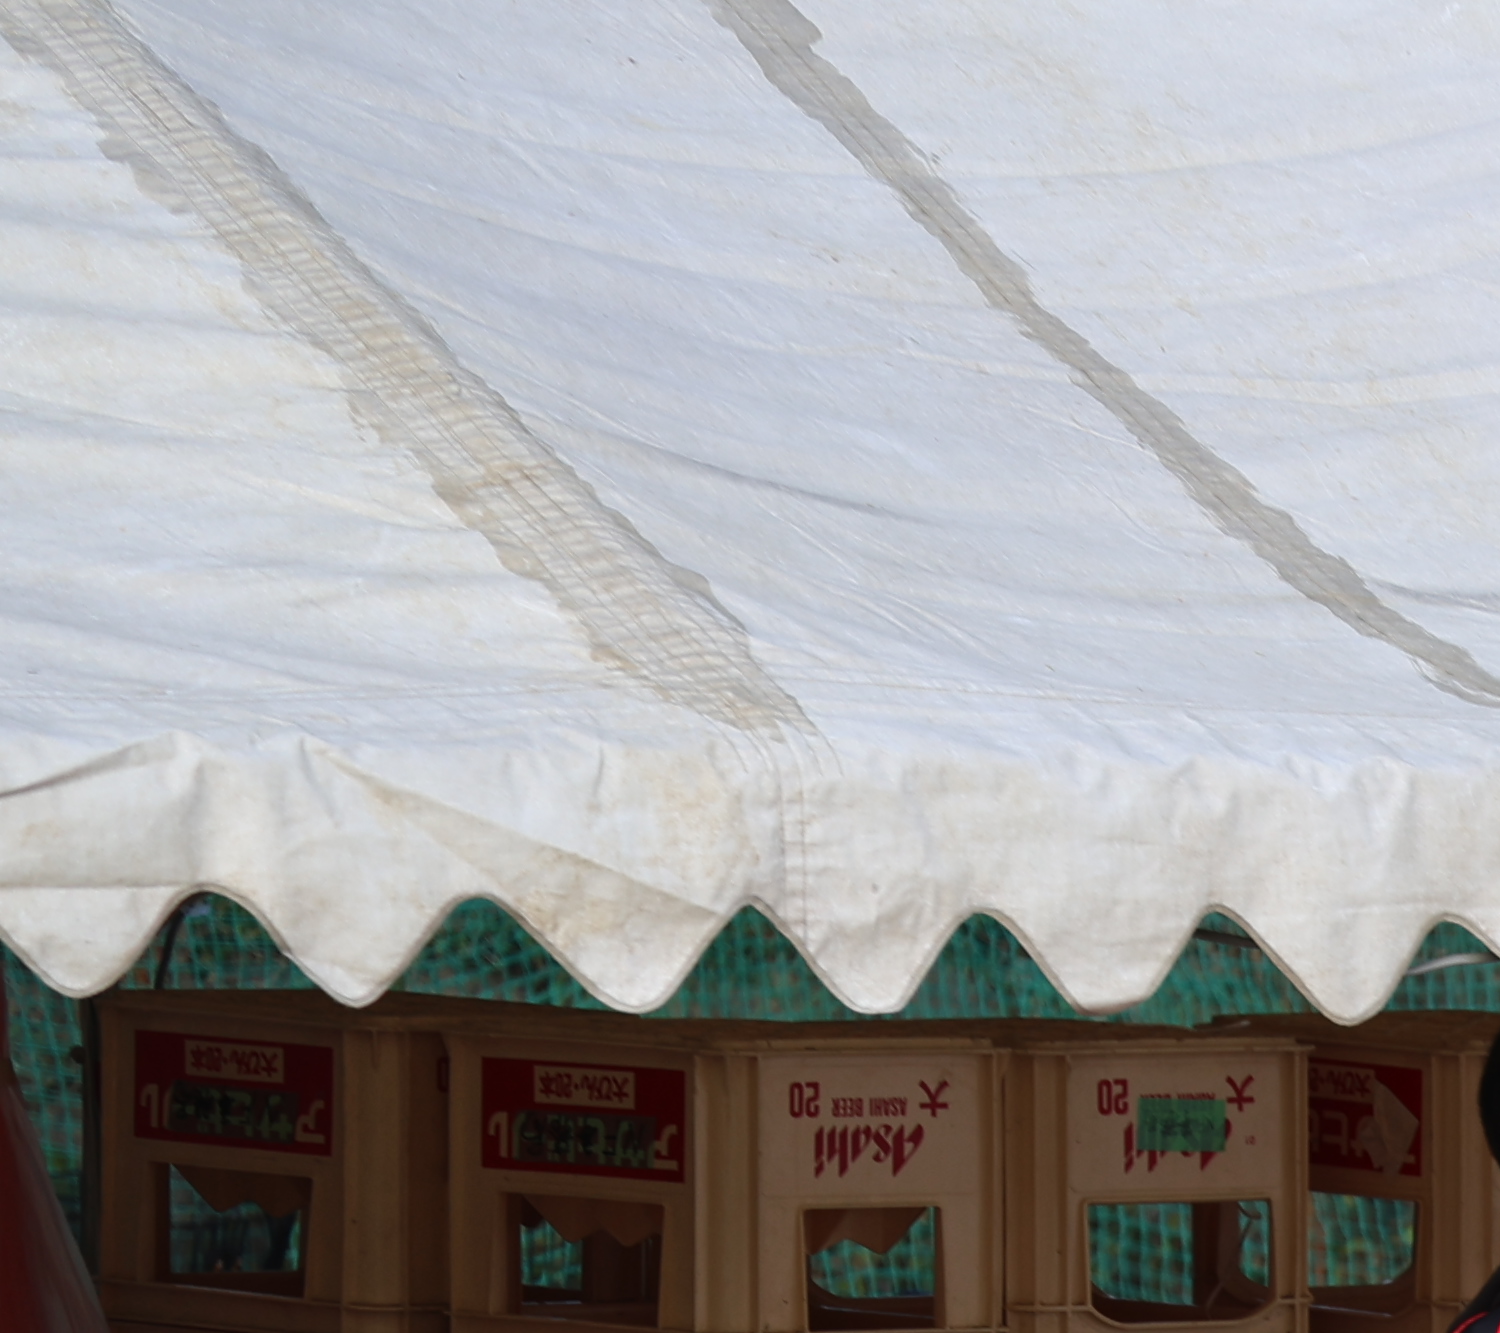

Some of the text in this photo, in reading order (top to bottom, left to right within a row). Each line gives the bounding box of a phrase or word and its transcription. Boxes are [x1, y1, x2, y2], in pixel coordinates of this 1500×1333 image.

[788, 1081, 819, 1118] 20
[830, 1097, 863, 1118] BEER
[917, 1079, 949, 1118] 大
[1097, 1078, 1128, 1116] 20
[1225, 1074, 1255, 1112] 大
[812, 1122, 925, 1178] Asahi
